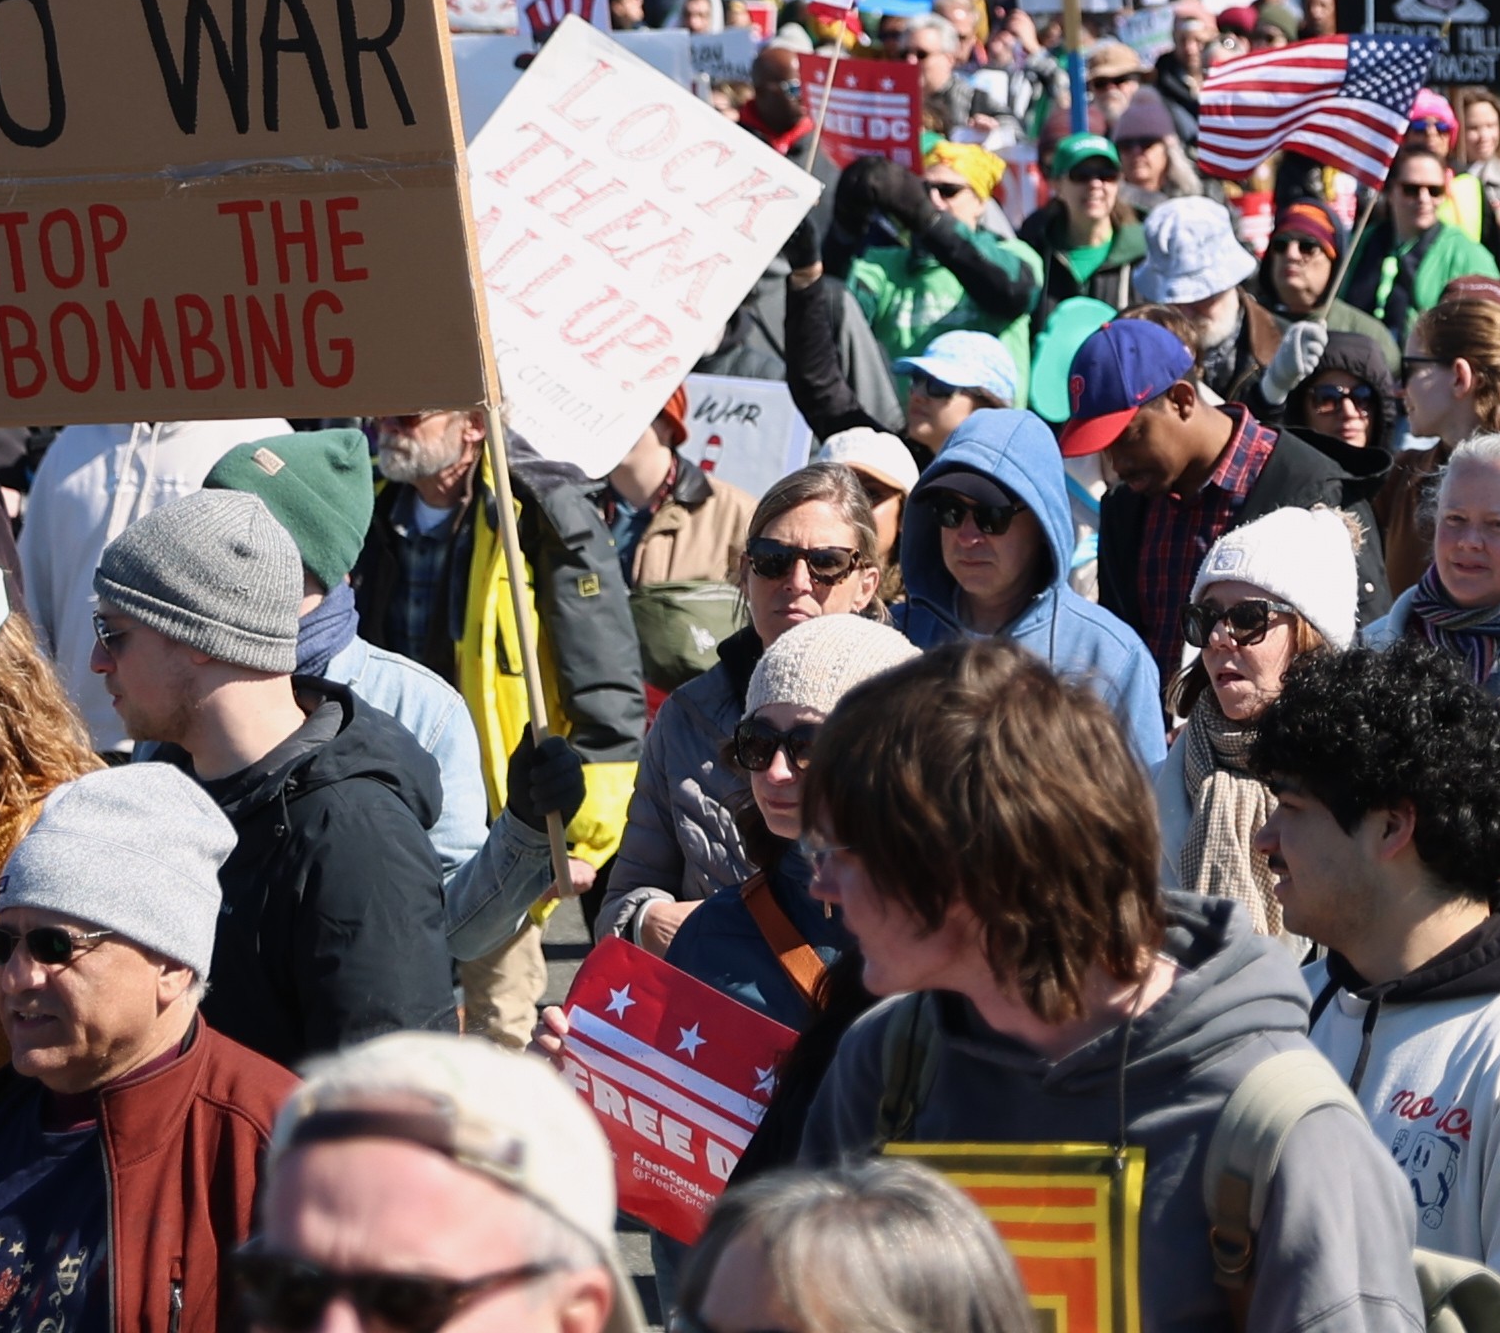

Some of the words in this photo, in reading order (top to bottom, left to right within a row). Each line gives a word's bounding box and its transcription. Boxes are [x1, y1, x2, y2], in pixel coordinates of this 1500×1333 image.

[1435, 55, 1500, 83] RACIST
[548, 58, 796, 242] LOCK
[868, 117, 911, 142] DC
[219, 196, 368, 286] THE
[487, 122, 731, 320] THEM
[558, 284, 681, 395] UP!
[693, 395, 762, 428] WAR
[557, 1056, 695, 1163] FREE
[705, 1128, 740, 1184] D
[1391, 1089, 1438, 1120] no
